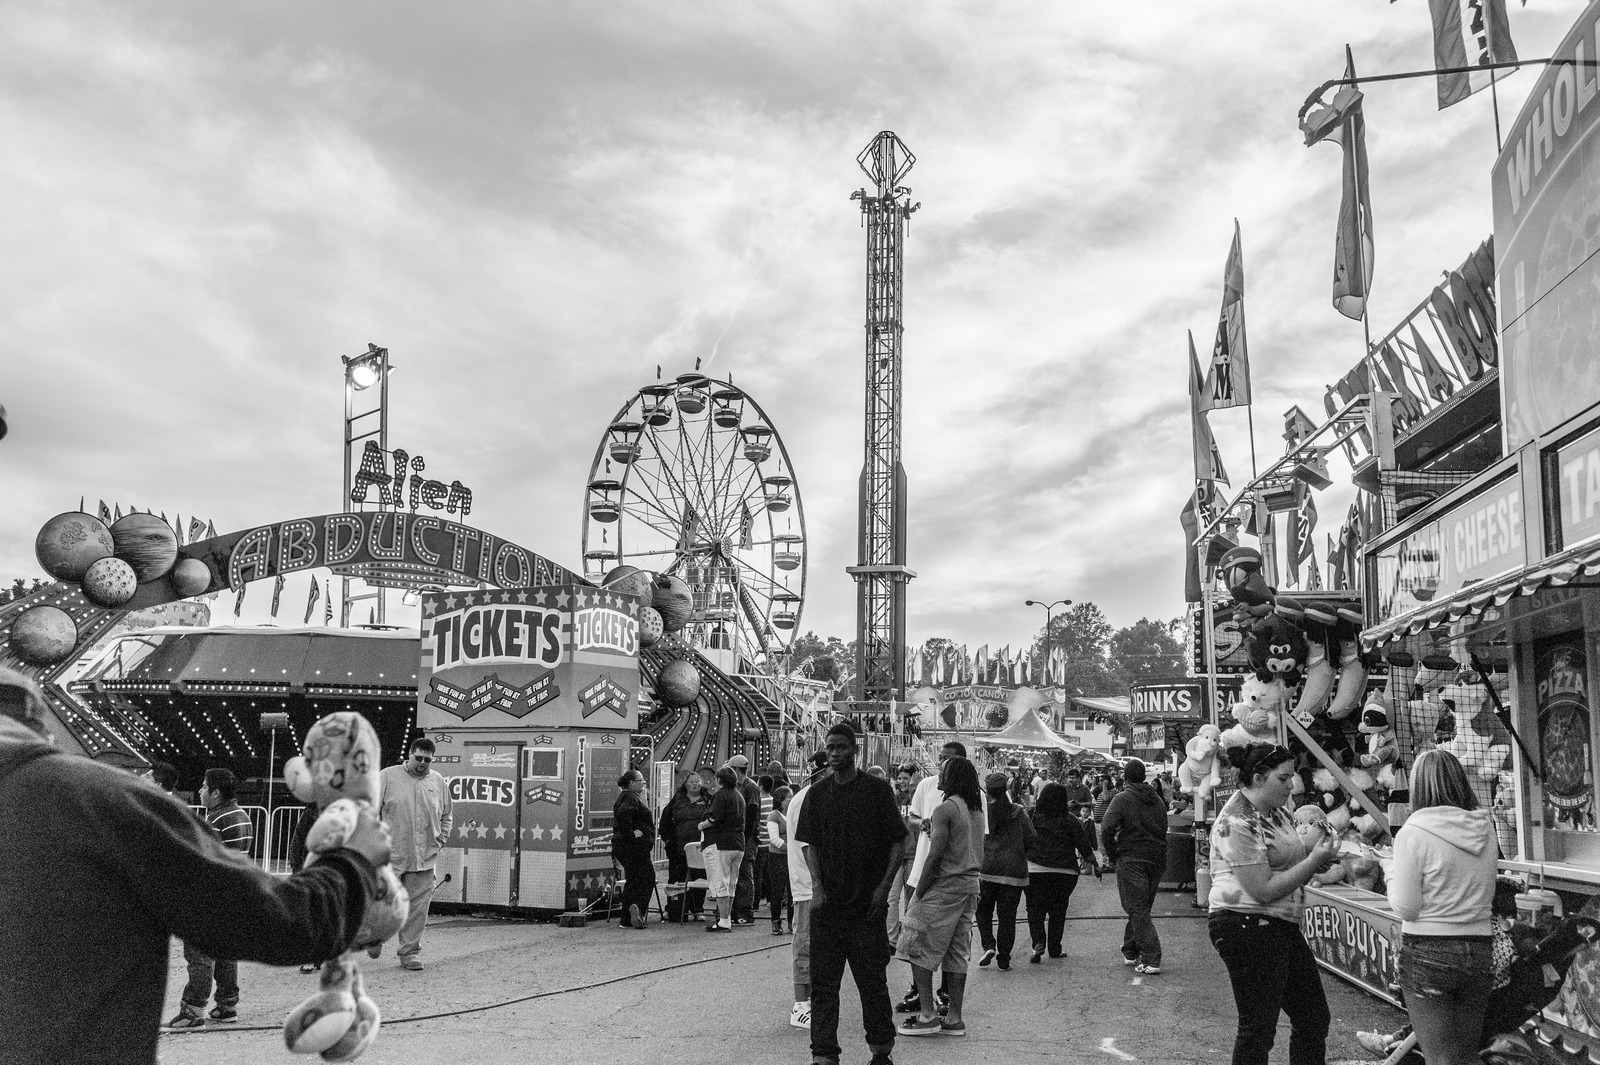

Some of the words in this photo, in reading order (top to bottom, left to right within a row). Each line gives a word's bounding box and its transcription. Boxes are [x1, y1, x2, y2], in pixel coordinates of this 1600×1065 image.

[351, 440, 472, 515] Alien
[1454, 489, 1521, 575] CHEESE
[228, 512, 565, 593] ABDUCTION
[432, 606, 562, 670] TICKETS
[576, 609, 636, 655] TICKETS
[437, 683, 449, 694] HAVE
[448, 688, 460, 698] FUN
[458, 693, 467, 701] AT
[477, 683, 487, 695] FUN
[485, 679, 494, 691] AT
[502, 687, 512, 698] FUN
[512, 691, 521, 700] AT
[533, 681, 543, 692] FUN
[542, 676, 550, 687] AT
[944, 689, 976, 701] COTON
[1538, 671, 1586, 705] PIZZA
[437, 695, 449, 706] THE
[447, 699, 460, 710] FAIR
[471, 699, 481, 710] THE
[480, 692, 492, 705] FAIR
[499, 698, 513, 709] FAIR
[527, 696, 537, 707] THE
[536, 689, 549, 702] FAIR
[1216, 690, 1243, 712] SA
[446, 776, 514, 806] CKETS
[575, 736, 587, 830] TICKETS
[1305, 905, 1341, 939] BEER
[1345, 910, 1390, 974] BUST
